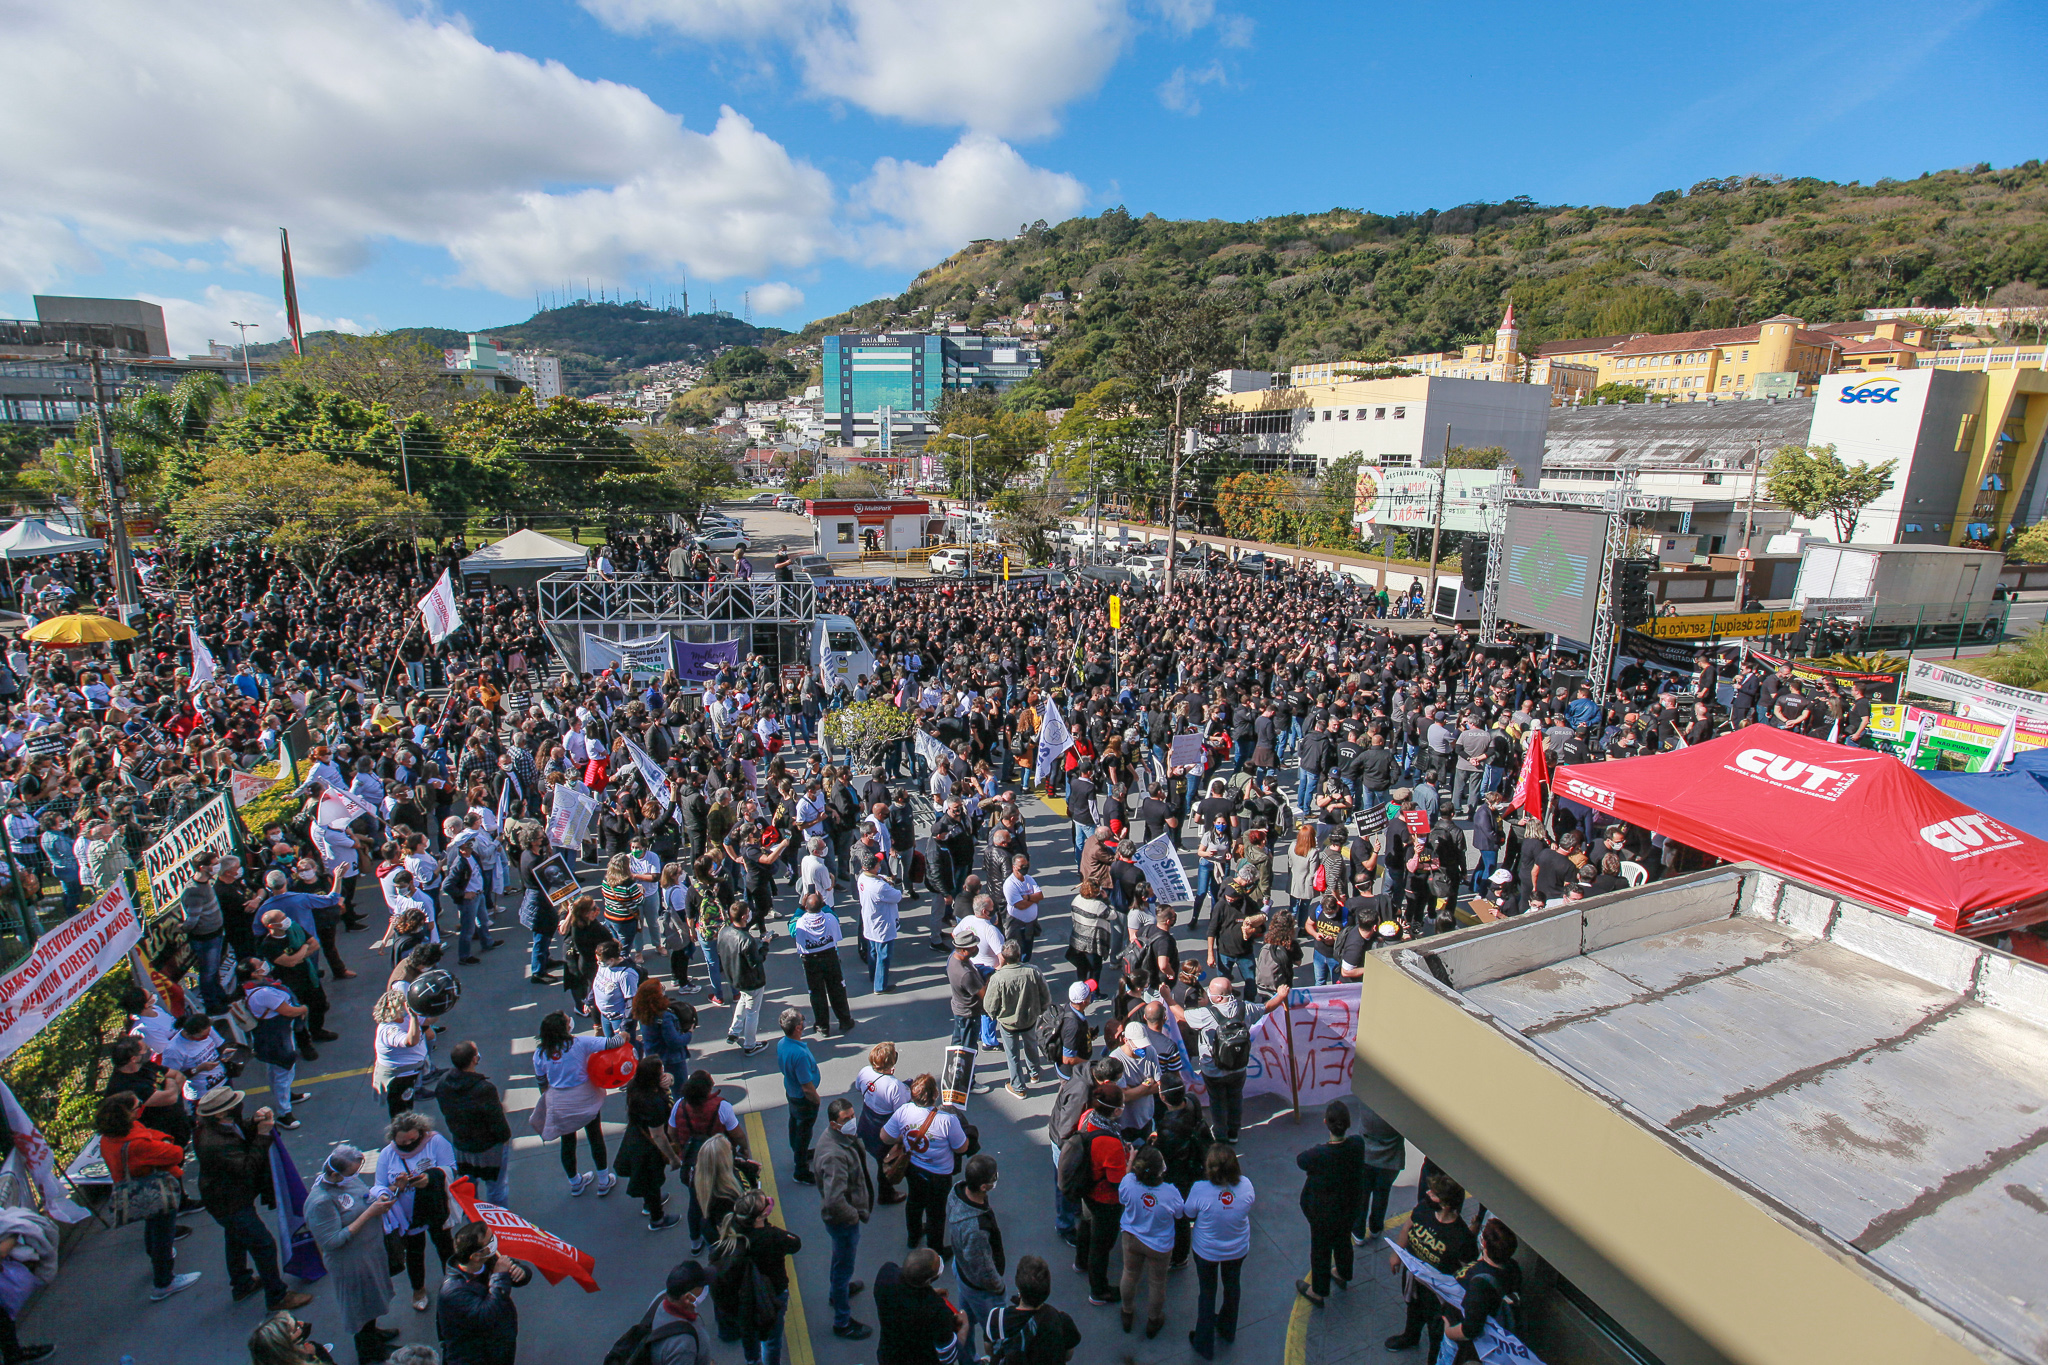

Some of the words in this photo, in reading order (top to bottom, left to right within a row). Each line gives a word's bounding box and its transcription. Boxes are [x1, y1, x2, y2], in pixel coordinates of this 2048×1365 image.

[1386, 470, 1424, 480] RESTAURANTE
[1406, 480, 1427, 493] AMOR
[1393, 506, 1426, 522] SABOR
[1938, 728, 1956, 738] LUCRO
[1976, 736, 1984, 744] DE
[1940, 718, 1946, 726] O
[1946, 719, 1970, 732] SISTEMA
[1936, 740, 1950, 748] NÃO
[1952, 743, 1970, 752] PUNA
[1736, 748, 1844, 790] CUT
[1566, 779, 1610, 803] CUT
[1724, 764, 1750, 776] CENTRAL
[1750, 774, 1769, 782] ÚNICA
[1783, 784, 1837, 802] TRABALHADORES
[150, 838, 176, 874] NÃO
[183, 800, 226, 850] REFORMA
[1920, 814, 2003, 853] CUT
[1152, 862, 1162, 878] Santa
[1161, 858, 1190, 902] SINTE
[154, 882, 170, 908] DA
[40, 908, 98, 966] PREVIDÊNCIA
[1317, 921, 1340, 932] LUTAR
[18, 969, 62, 1016] NENHUM
[59, 940, 100, 980] DIREITO
[42, 995, 63, 1020] SINTE
